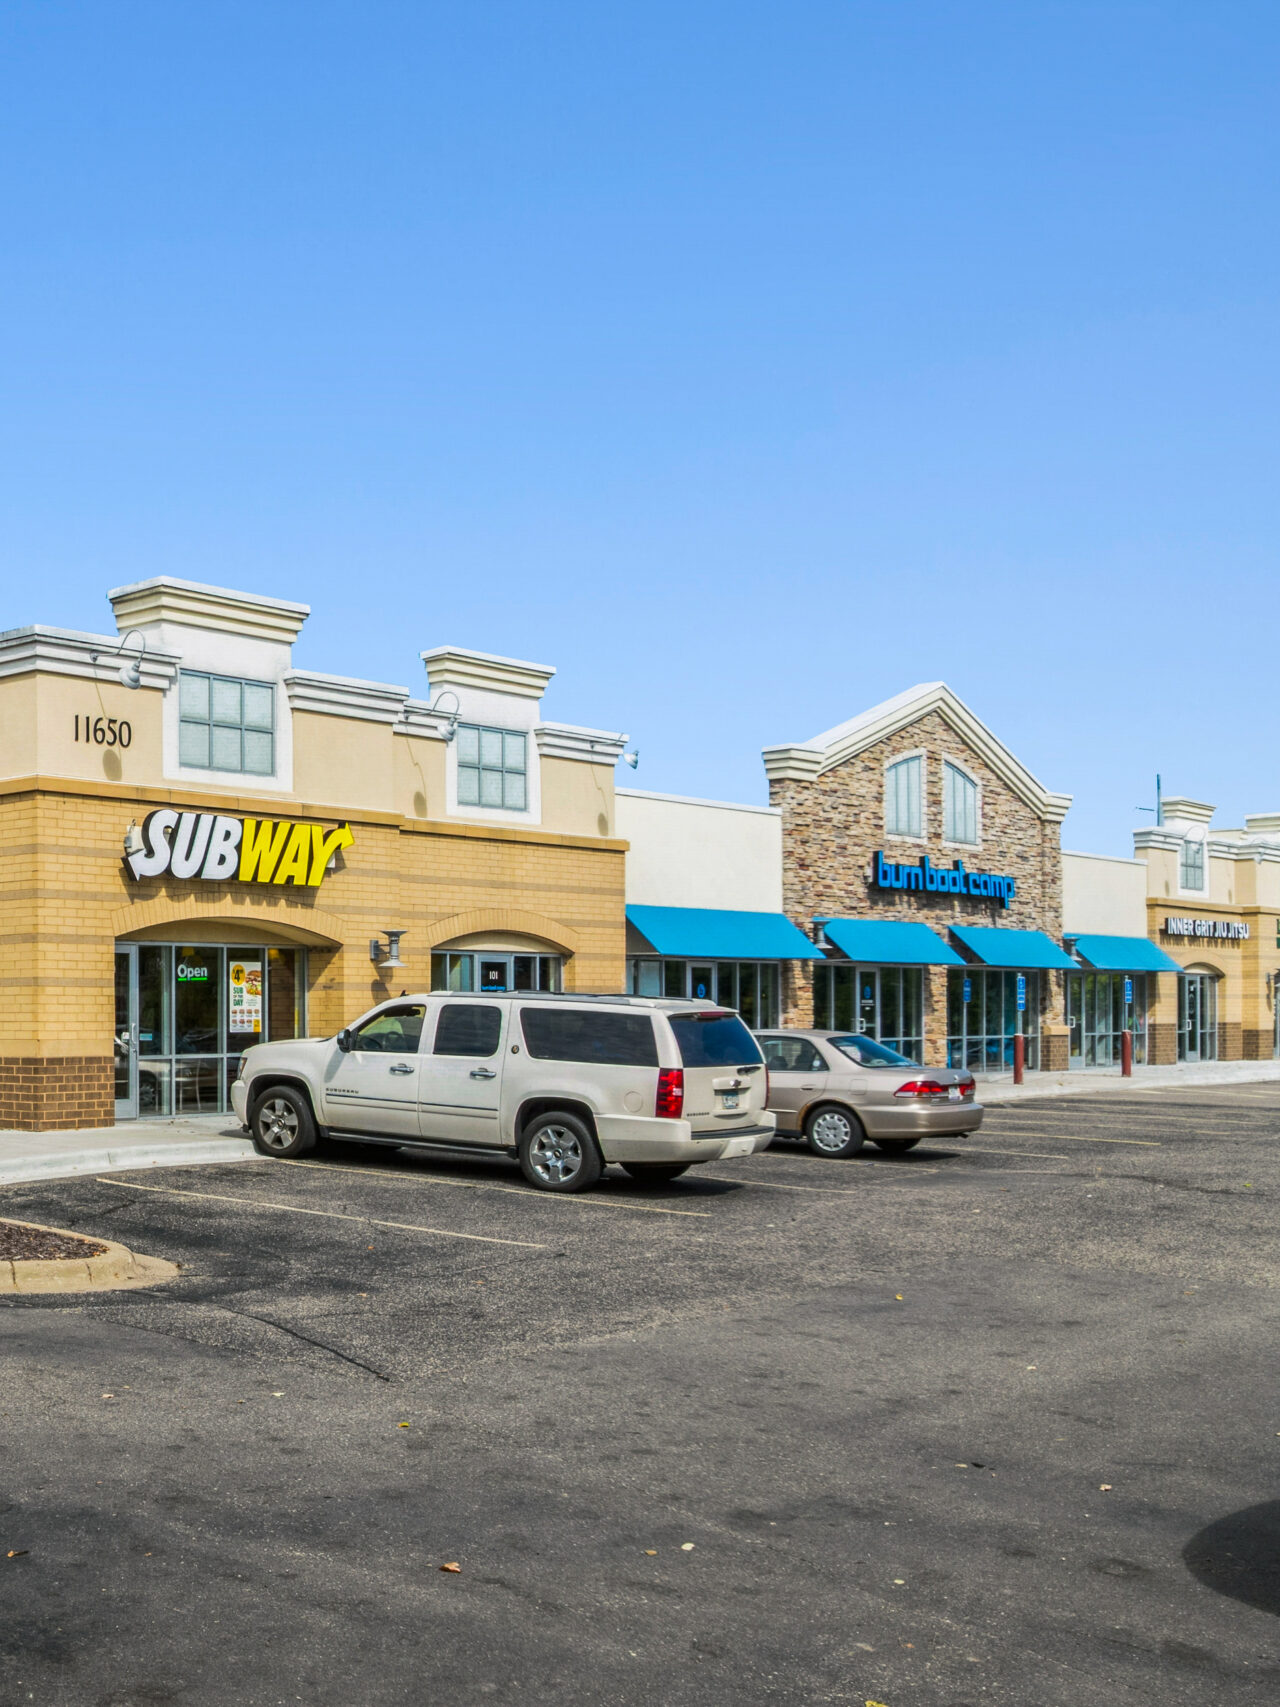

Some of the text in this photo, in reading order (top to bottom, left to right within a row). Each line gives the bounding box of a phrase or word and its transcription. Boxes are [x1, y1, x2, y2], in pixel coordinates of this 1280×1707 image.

[74, 714, 132, 748] 11650
[121, 809, 355, 888] SUBWAY
[877, 850, 1015, 910] burn boot camp
[1167, 917, 1250, 939] INNER GRIT JIU JITSU
[177, 964, 208, 981] Open
[489, 970, 498, 980] 101
[233, 986, 244, 994] SUB
[233, 998, 244, 1007] DAY
